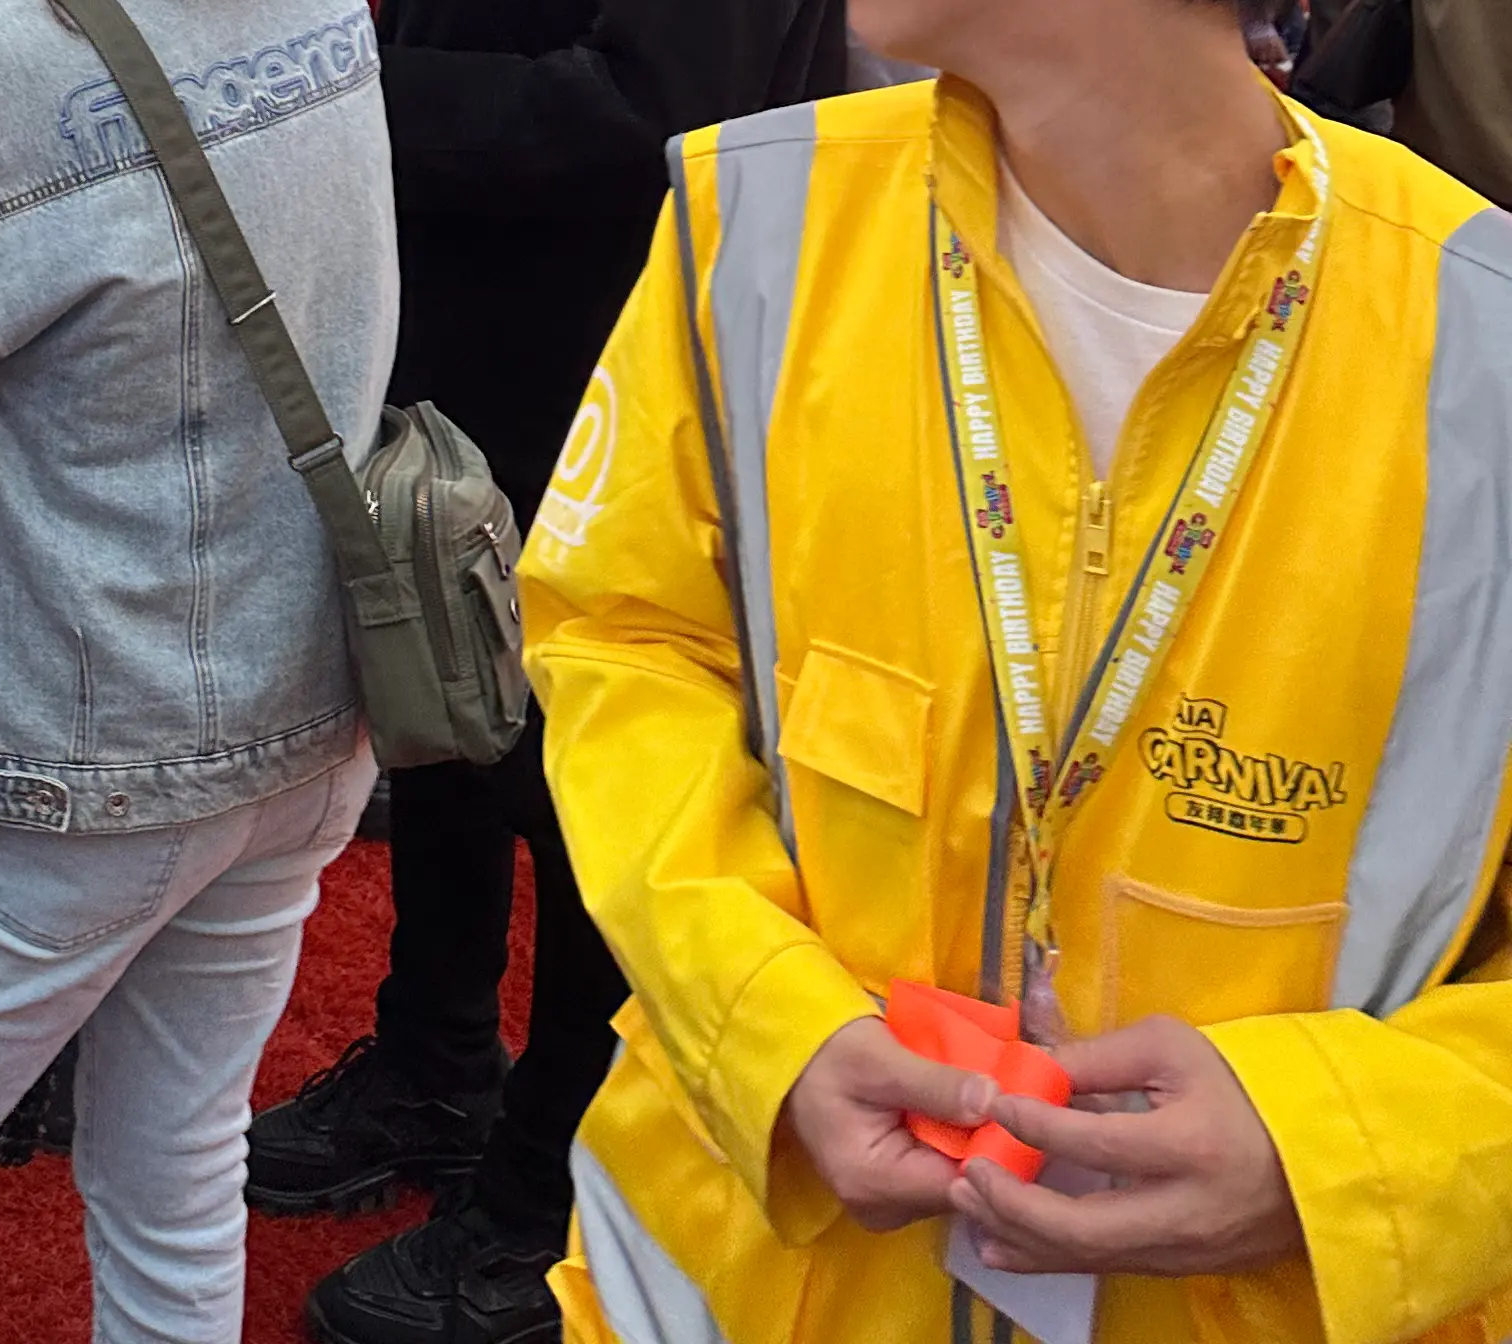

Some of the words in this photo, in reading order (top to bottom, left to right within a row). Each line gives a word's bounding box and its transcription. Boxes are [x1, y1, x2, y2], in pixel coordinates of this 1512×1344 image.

[951, 289, 986, 386] BIRTHDAY
[1236, 338, 1285, 411] HAPPY
[963, 391, 999, 461] HAPPY
[1195, 406, 1256, 509] BIRTHDAY
[989, 550, 1034, 655] BIRTHDAY
[1132, 580, 1182, 653] HAPPY
[1008, 661, 1045, 735] HAPPY
[1090, 647, 1152, 747] BIRTHDAY
[1176, 704, 1217, 730] IA
[1138, 726, 1347, 812] CARNIVAL
